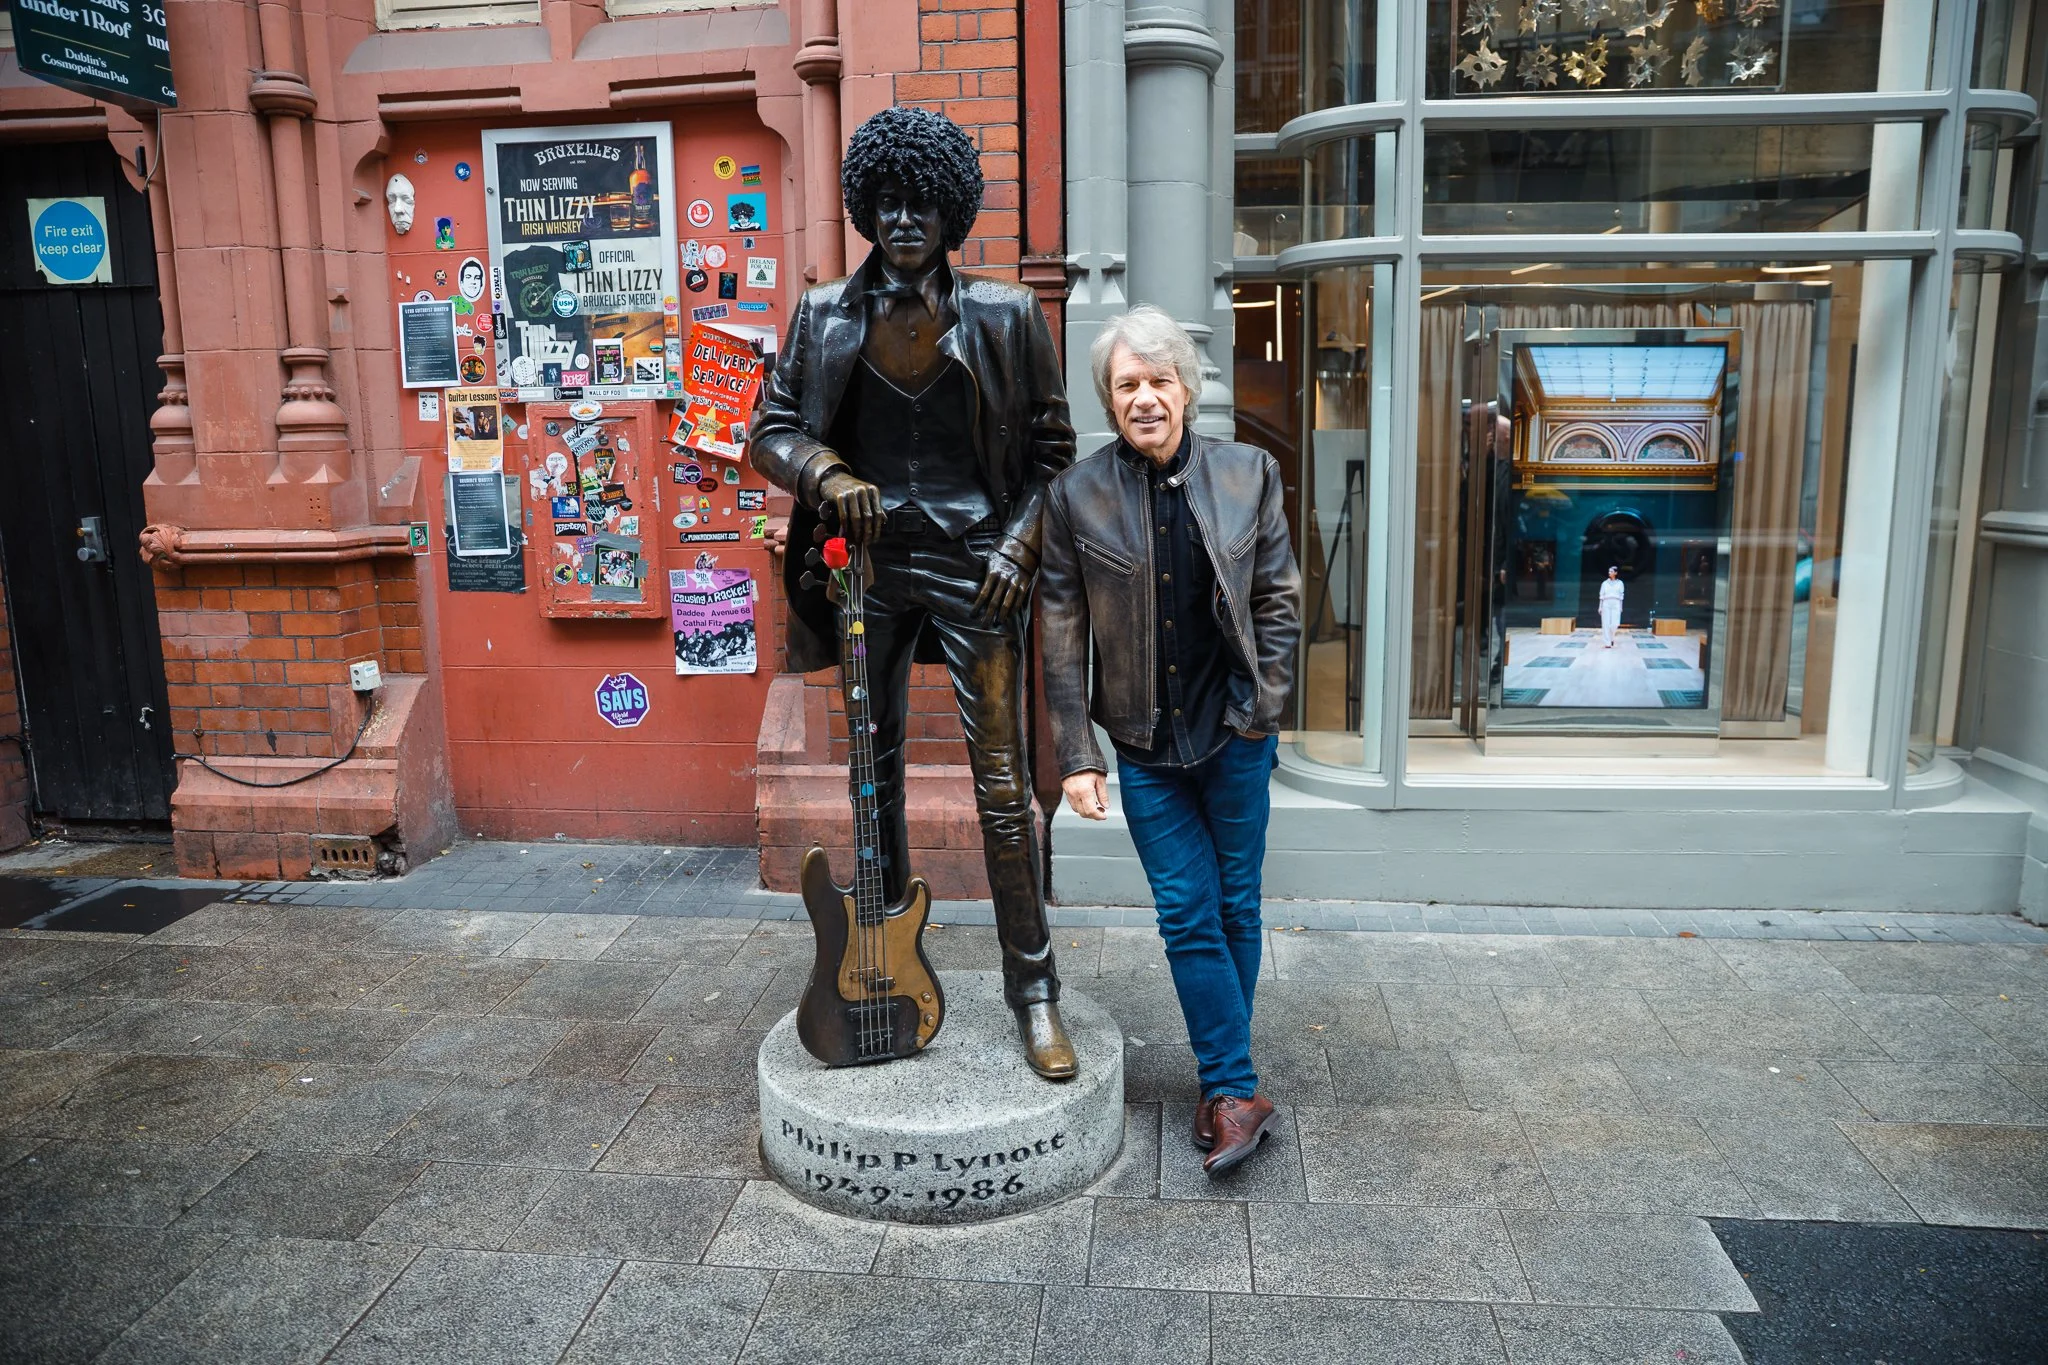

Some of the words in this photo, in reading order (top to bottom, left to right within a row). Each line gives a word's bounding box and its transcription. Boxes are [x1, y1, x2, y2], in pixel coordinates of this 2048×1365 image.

[20, 0, 79, 23] under
[91, 10, 132, 39] Roof
[64, 47, 107, 68] Dublin's
[41, 53, 110, 80] Cosmopolitan
[110, 70, 129, 85] Pub
[534, 143, 621, 165] BRUXELLES
[520, 178, 541, 192] NOW
[542, 176, 579, 191] SERVING
[504, 197, 547, 222] THIN
[550, 195, 597, 221] LIZZY
[44, 225, 68, 237] Fire
[71, 224, 94, 237] exit
[521, 221, 544, 236] IRISH
[545, 220, 582, 235] WHISKEY
[39, 243, 69, 257] keep
[72, 242, 103, 254] clear
[599, 250, 636, 264] OFFICIAL
[576, 271, 615, 294] THIN
[618, 267, 663, 292] LIZZY
[583, 295, 627, 309] BRUXELLES
[628, 292, 656, 306] MERCH
[693, 344, 757, 374] DELIVERY
[692, 366, 752, 394] SERVICE!
[448, 393, 468, 402] Guitar
[469, 393, 498, 402] Lessons
[674, 593, 706, 605] Causing
[714, 581, 750, 602] Racket!
[676, 609, 705, 617] Daddee
[711, 608, 739, 617] Avenue
[683, 619, 707, 627] Cathal
[708, 619, 723, 627] Fitz
[599, 688, 645, 713] SAVS
[611, 711, 629, 720] World
[617, 717, 637, 725] Famous
[782, 1119, 882, 1172] Philip
[893, 1151, 918, 1172] P
[931, 1131, 1066, 1178] Lynott
